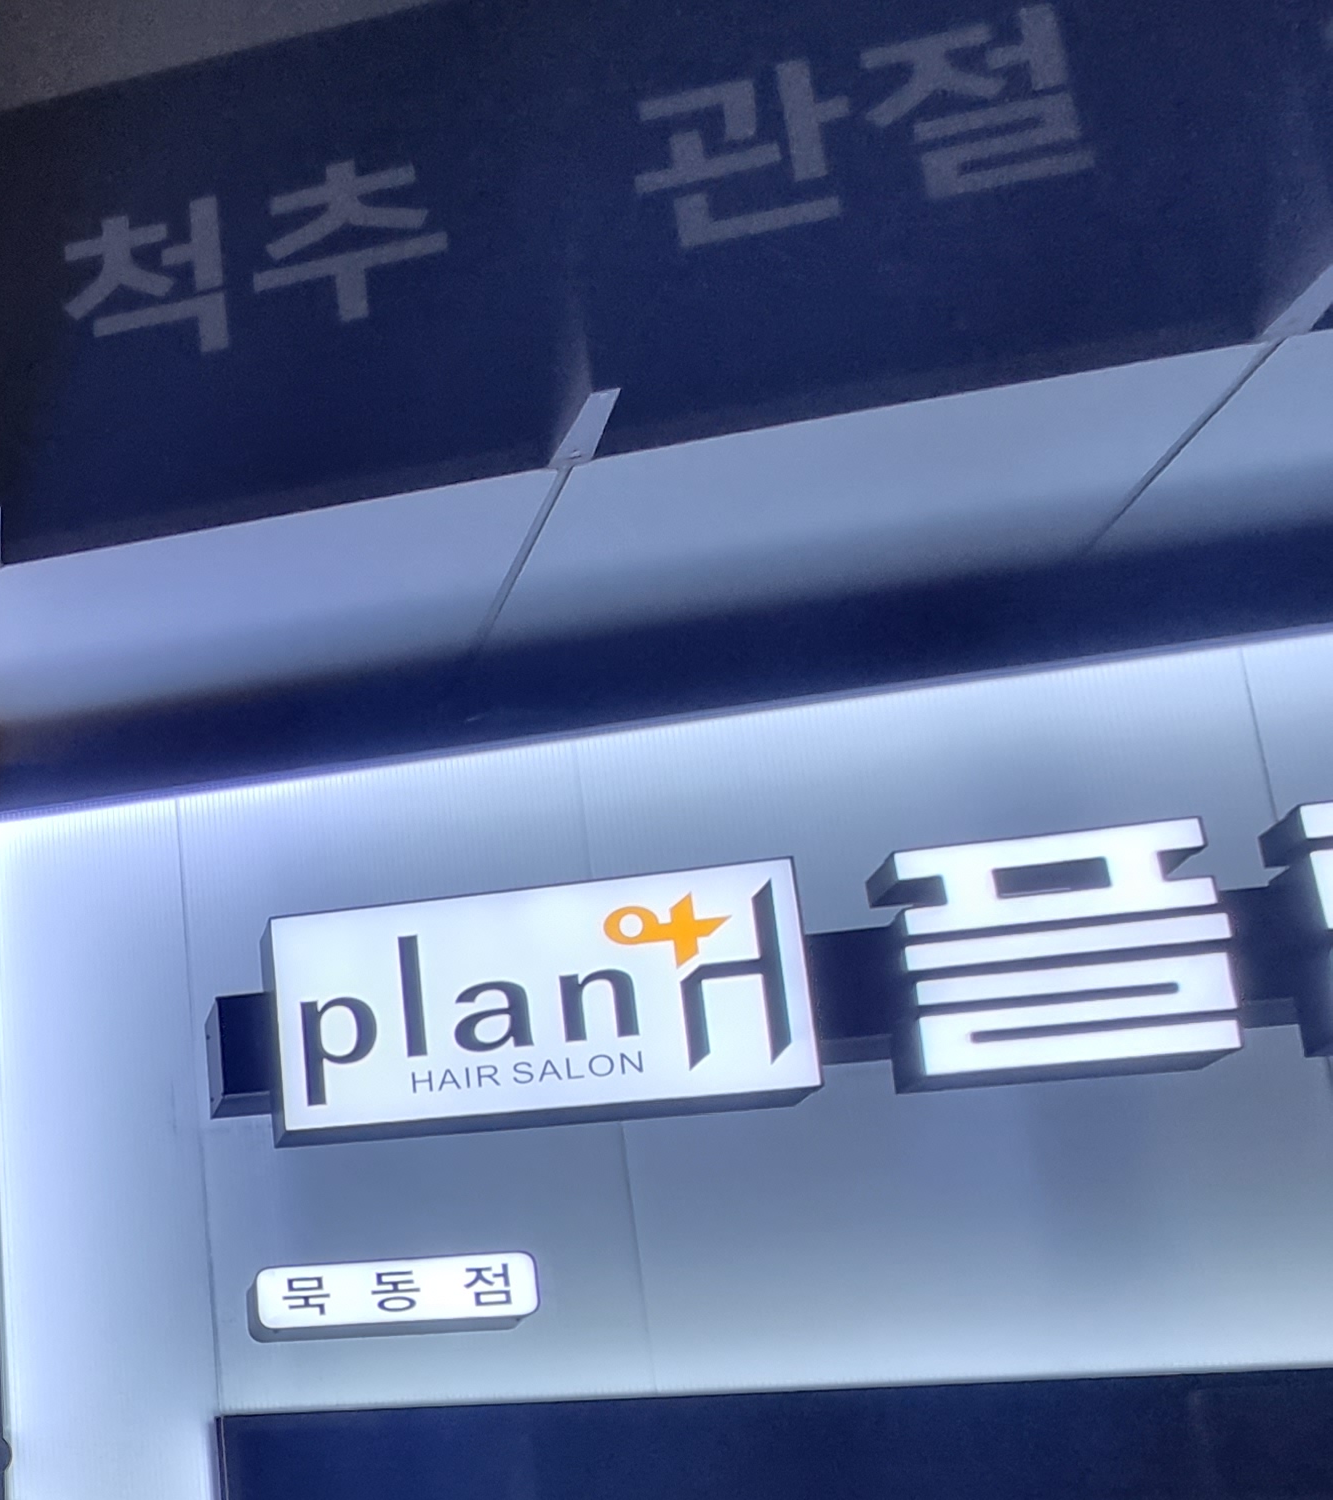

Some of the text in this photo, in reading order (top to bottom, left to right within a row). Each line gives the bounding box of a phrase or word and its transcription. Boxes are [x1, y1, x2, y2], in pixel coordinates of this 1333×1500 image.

[63, 158, 449, 354] 척추
[634, 3, 1097, 250] 관절
[410, 1049, 645, 1095] HAIR SALON
[888, 815, 1333, 1078] 플
